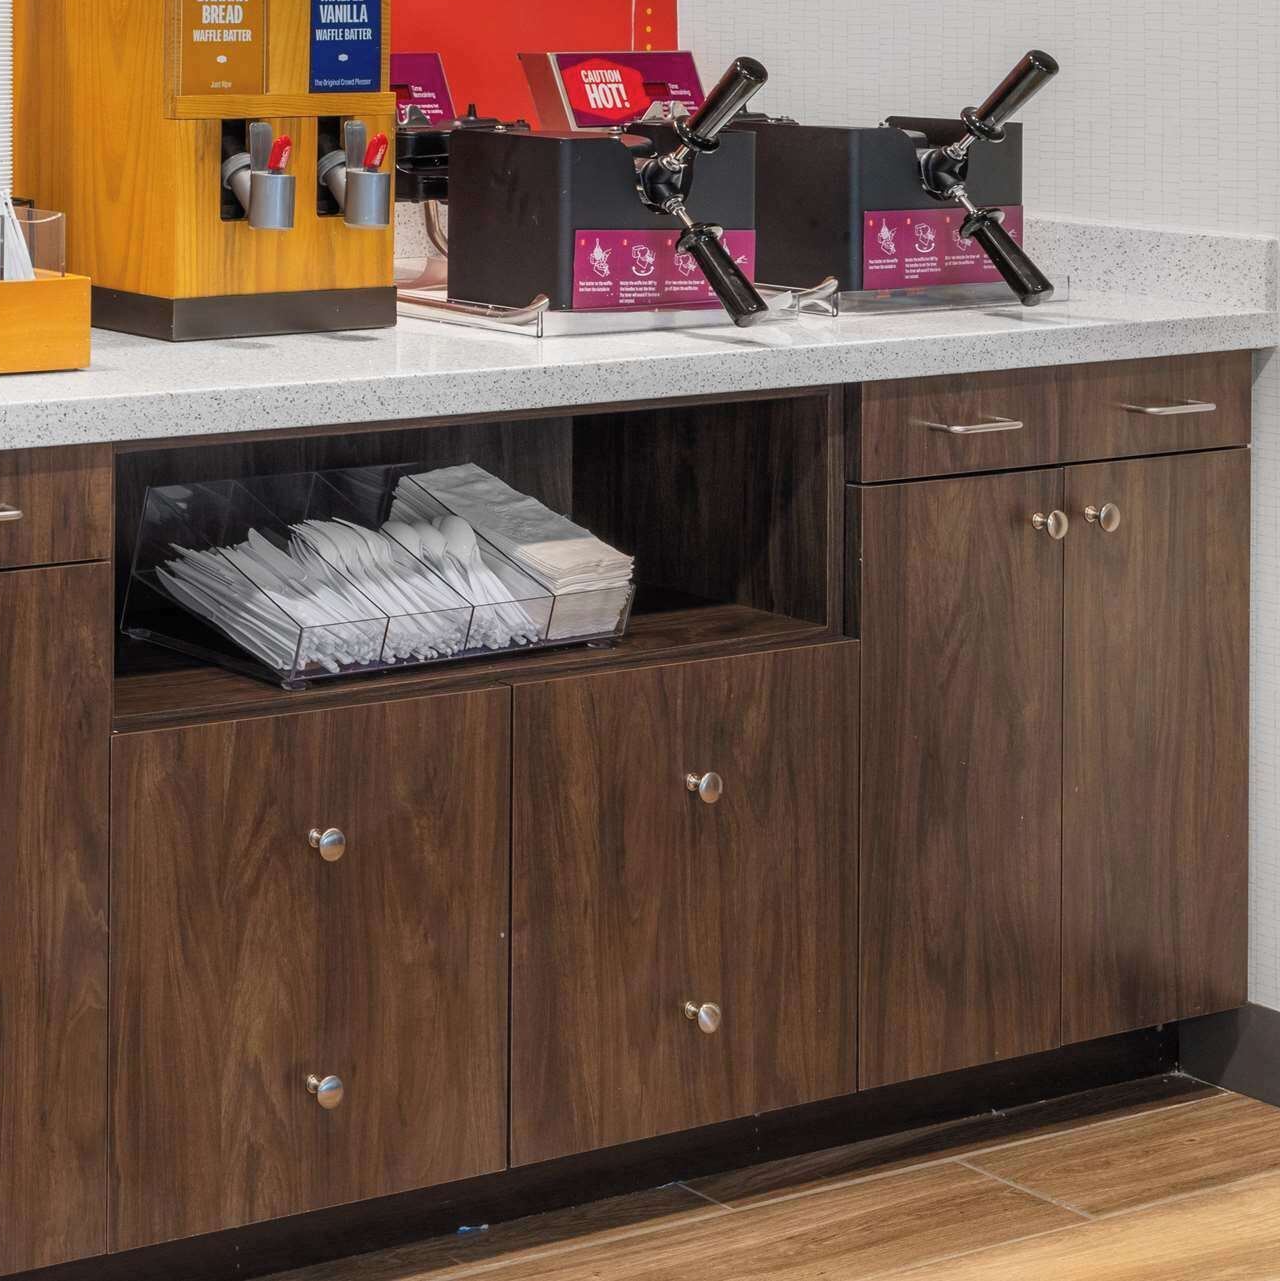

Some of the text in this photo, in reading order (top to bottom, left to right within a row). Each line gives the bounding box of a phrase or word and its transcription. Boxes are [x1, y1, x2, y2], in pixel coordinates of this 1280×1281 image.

[202, 5, 243, 24] BREAD
[320, 4, 368, 23] VANILLA
[192, 29, 252, 42] WAFFLE BATTER
[316, 28, 372, 41] WAFFLE BATTER
[581, 69, 622, 83] CAUTION
[584, 83, 630, 109] HOT!
